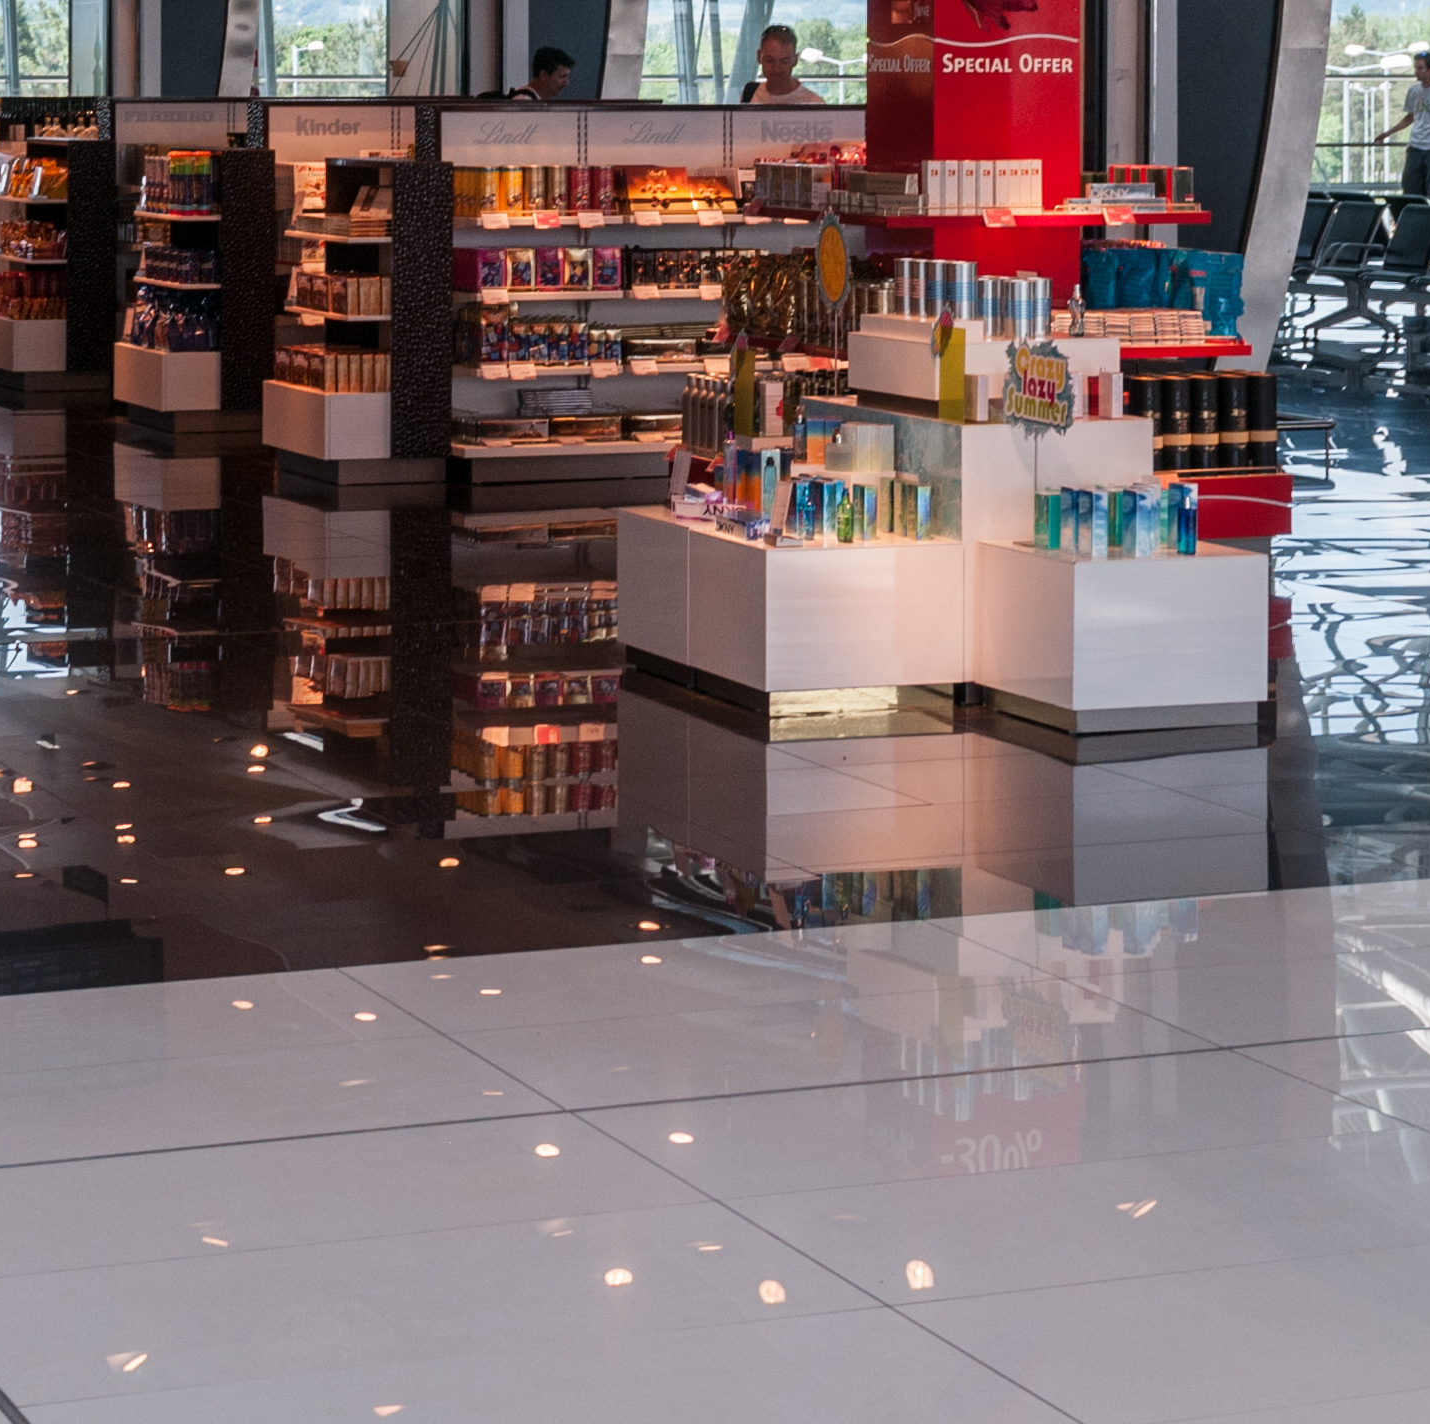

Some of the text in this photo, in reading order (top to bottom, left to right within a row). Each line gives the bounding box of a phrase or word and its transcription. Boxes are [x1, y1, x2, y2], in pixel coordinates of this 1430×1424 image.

[942, 52, 1073, 74] SPECIAL OFFER
[295, 116, 362, 137] Kinder
[473, 121, 539, 145] Lindt
[622, 121, 686, 145] Lindt
[1091, 187, 1130, 199] DKNY
[1015, 345, 1066, 392] Crazy
[1022, 369, 1056, 409] lazy
